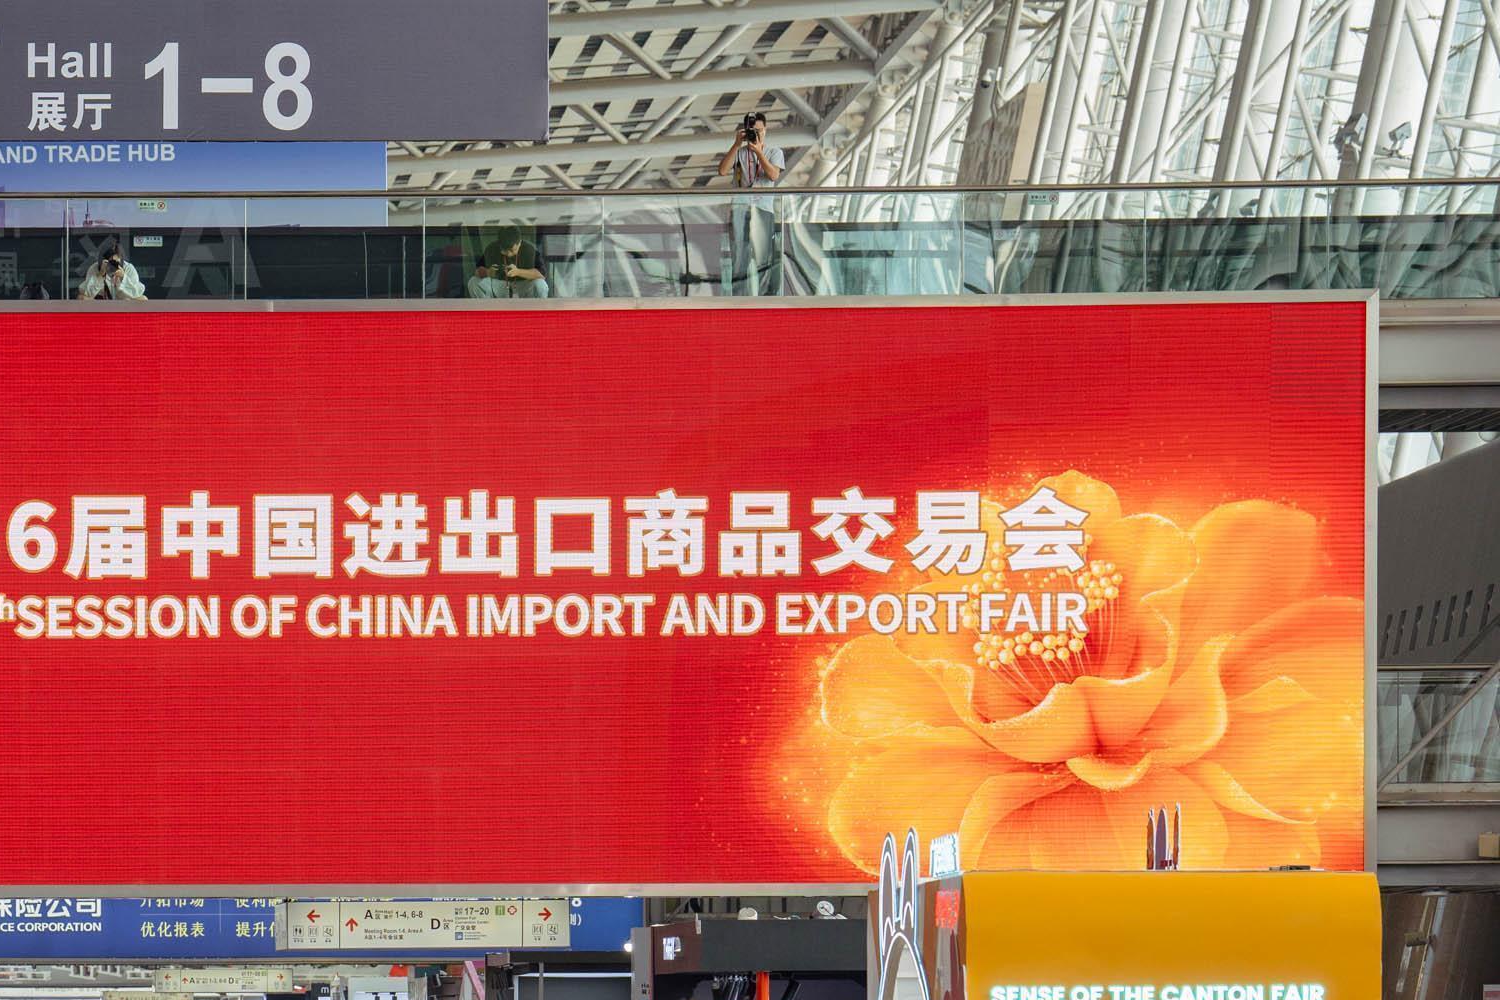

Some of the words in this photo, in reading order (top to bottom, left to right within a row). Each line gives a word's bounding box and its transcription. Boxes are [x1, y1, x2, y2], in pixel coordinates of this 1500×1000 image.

[27, 42, 112, 78] Hall
[144, 42, 313, 131] 1-8
[27, 92, 112, 132] 展厅
[44, 144, 120, 163] TRADE
[128, 143, 175, 162] HUB
[230, 595, 298, 639] OF
[306, 594, 459, 639] CHINA
[465, 593, 656, 637] IMPORT
[660, 593, 765, 637] AND
[776, 592, 968, 636] EXPORT
[978, 592, 1089, 635] FAIR
[364, 909, 373, 920] A
[411, 910, 424, 919] 6-8
[465, 906, 490, 916] 17-20
[17, 922, 102, 933] CORPORATION
[140, 921, 205, 938] 优化报表
[431, 918, 441, 930] D
